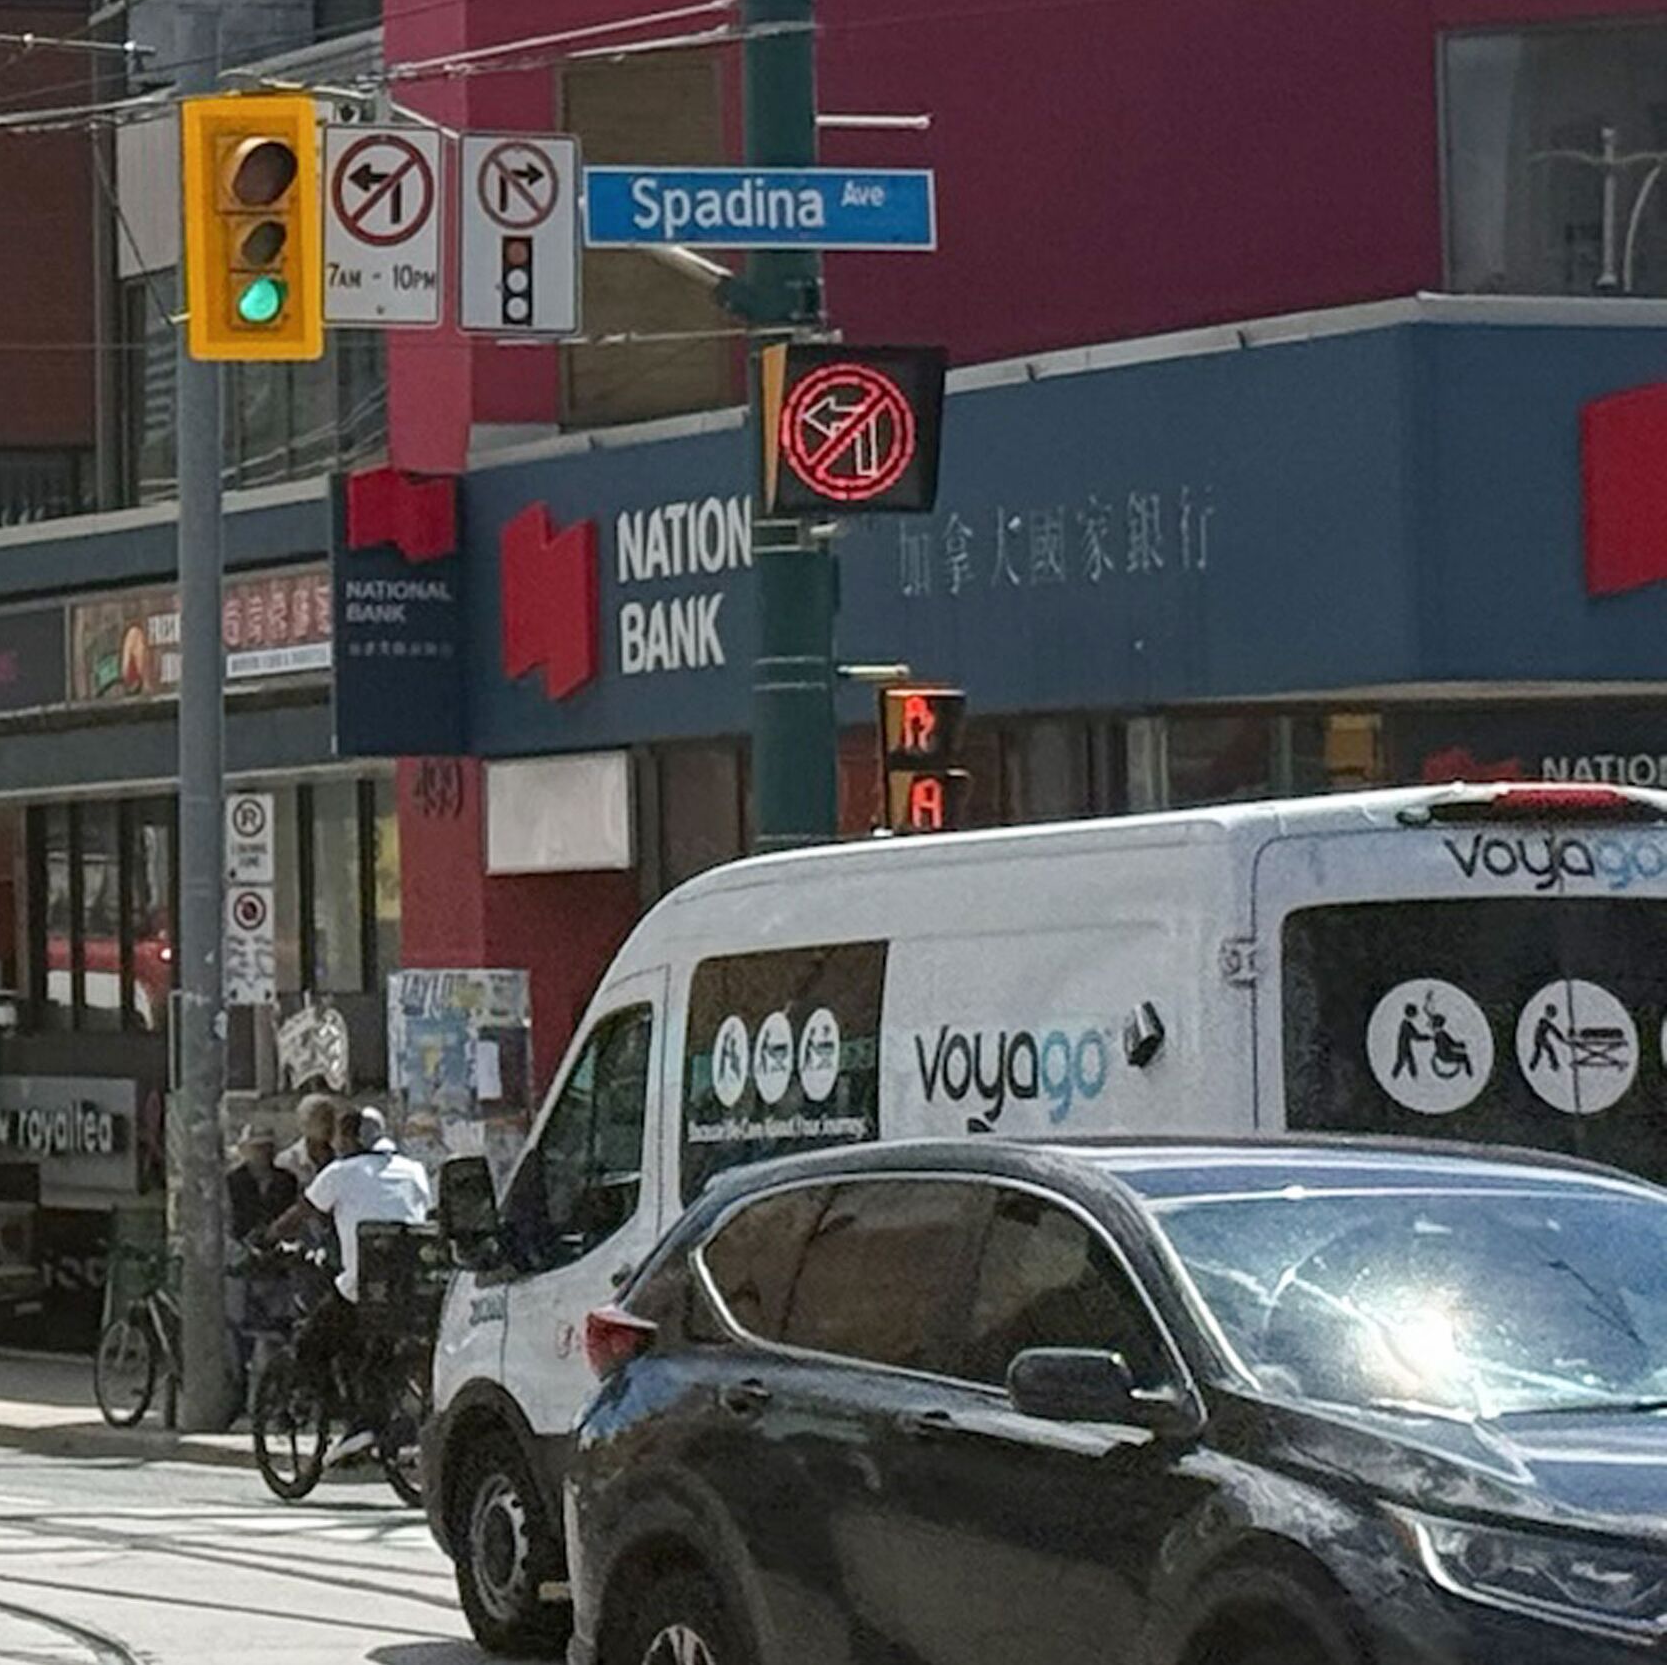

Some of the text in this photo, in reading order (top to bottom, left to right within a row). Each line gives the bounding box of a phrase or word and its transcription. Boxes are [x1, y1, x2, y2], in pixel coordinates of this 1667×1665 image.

[631, 178, 885, 238] Spadina Ave
[327, 263, 362, 290] 7AM
[392, 263, 437, 291] 10PM
[616, 494, 754, 584] NATION
[346, 580, 451, 601] NATIONAL
[346, 603, 407, 625] BANK
[620, 592, 726, 675] BANK
[1541, 752, 1667, 785] NATIO
[17, 1100, 113, 1157] royaltea
